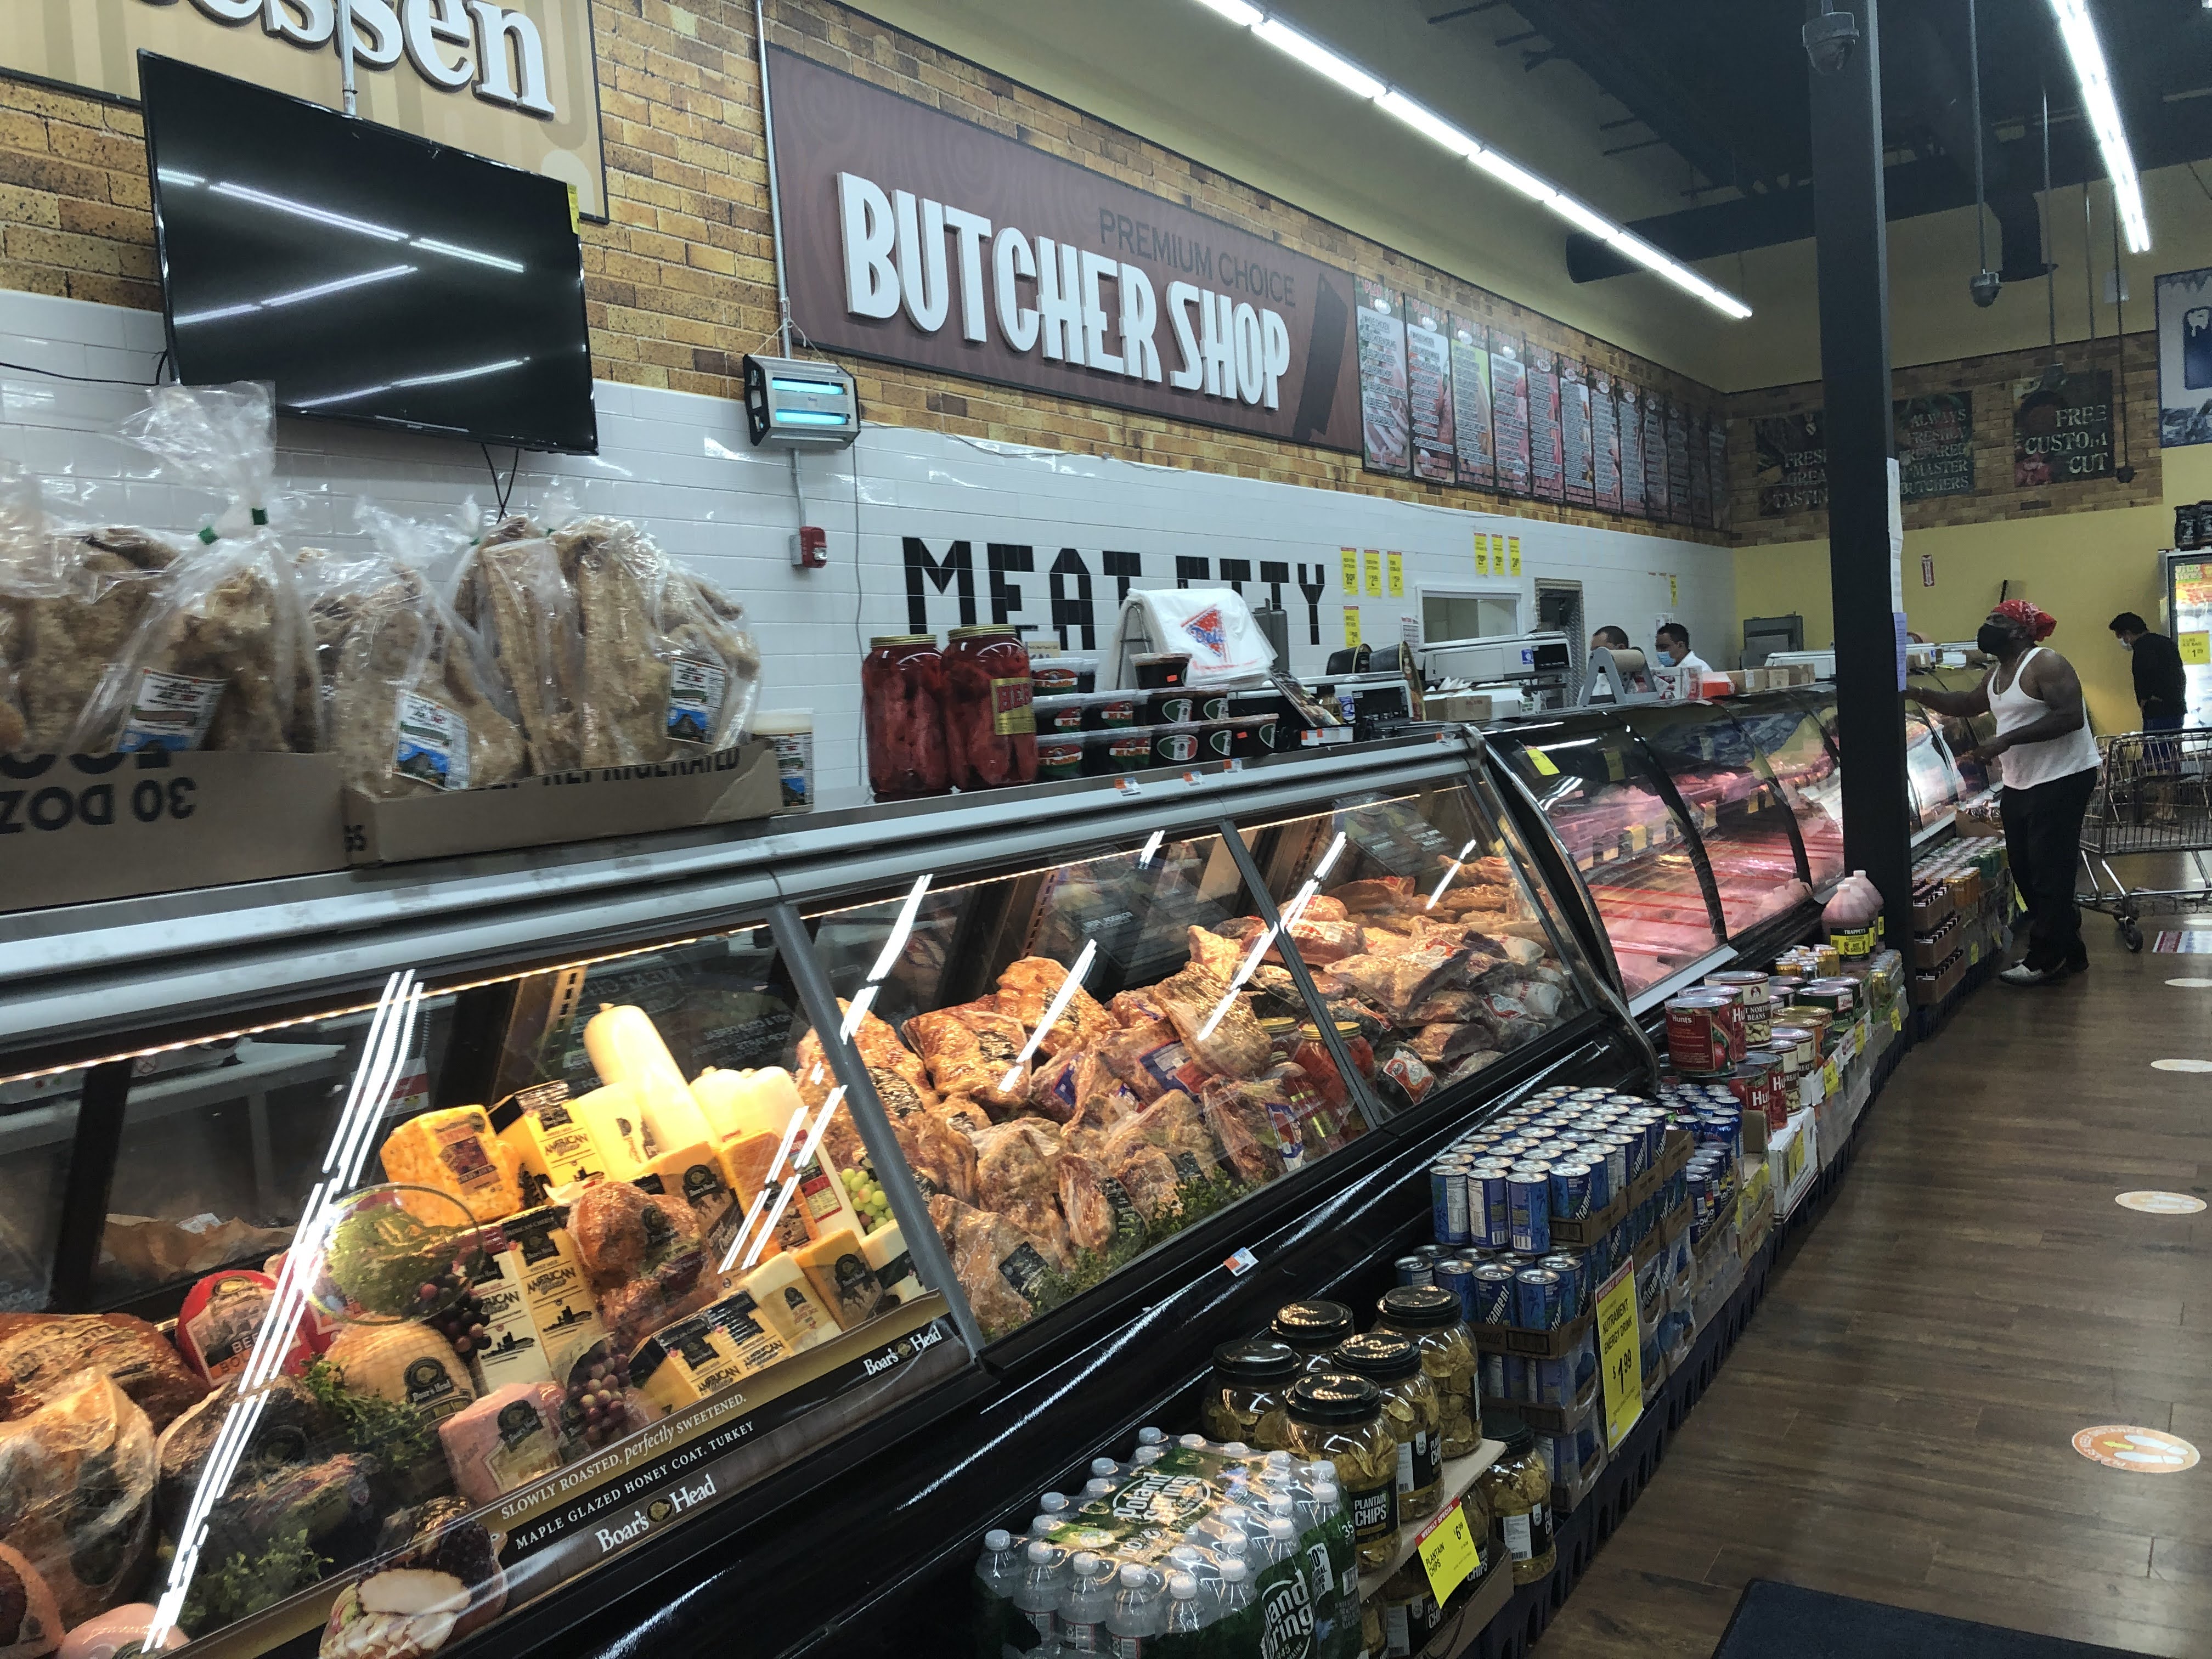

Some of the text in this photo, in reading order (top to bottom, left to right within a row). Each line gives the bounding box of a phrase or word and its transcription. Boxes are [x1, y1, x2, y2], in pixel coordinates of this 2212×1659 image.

[1099, 207, 1296, 308] PREMIUM CHOICE
[837, 171, 1163, 383] BUTCHER
[1165, 280, 1291, 411] SHOP
[1910, 409, 1967, 428] ALWAYS
[2055, 404, 2107, 427] FREE
[1908, 427, 1967, 443] FRESHLY
[2025, 431, 2108, 455] CUSTOM
[1912, 459, 1968, 477] MASTER
[2068, 452, 2108, 474] CUT
[1773, 488, 1829, 509] TASTIN
[1900, 476, 1970, 495] BUTCHERS
[902, 536, 1142, 651] MEAT
[133, 777, 196, 823] 30
[1672, 1014, 1692, 1024] Hunt's
[1733, 1007, 1745, 1023] Hu
[1747, 1012, 1766, 1021] BEANS
[544, 1133, 589, 1156] AMERICAN
[527, 1267, 577, 1295] AMERICAN
[1485, 1284, 1510, 1325] trament
[1602, 1297, 1629, 1337] NUTRAMENT
[1604, 1315, 1633, 1355] ENERGY DRINK
[219, 1352, 251, 1372] BOL
[863, 1324, 943, 1376] Boar's Head
[697, 1365, 741, 1396] AMERICAN
[1430, 1432, 1441, 1452] PLAN
[501, 1393, 747, 1520] SLOWLY ROASTED, perfectly SWEETENED.
[515, 1517, 565, 1550] MAPLE
[568, 1489, 621, 1523] GLAZED
[624, 1464, 668, 1494] HONEY
[708, 1421, 755, 1451] TURKEY
[1113, 1471, 1175, 1520] Poland
[1143, 1475, 1202, 1522] Spring
[595, 1473, 717, 1553] Boar's Head
[1354, 1492, 1386, 1510] PLANTAIN
[1355, 1504, 1387, 1527] CHIPS
[1421, 1504, 1454, 1539] WEEKLY SPECIAL
[1341, 1520, 1355, 1538] 35
[1425, 1542, 1446, 1568] PLANTAIN
[1429, 1559, 1441, 1578] CHIPS
[1264, 1568, 1310, 1632] land
[1262, 1602, 1314, 1659] pring
